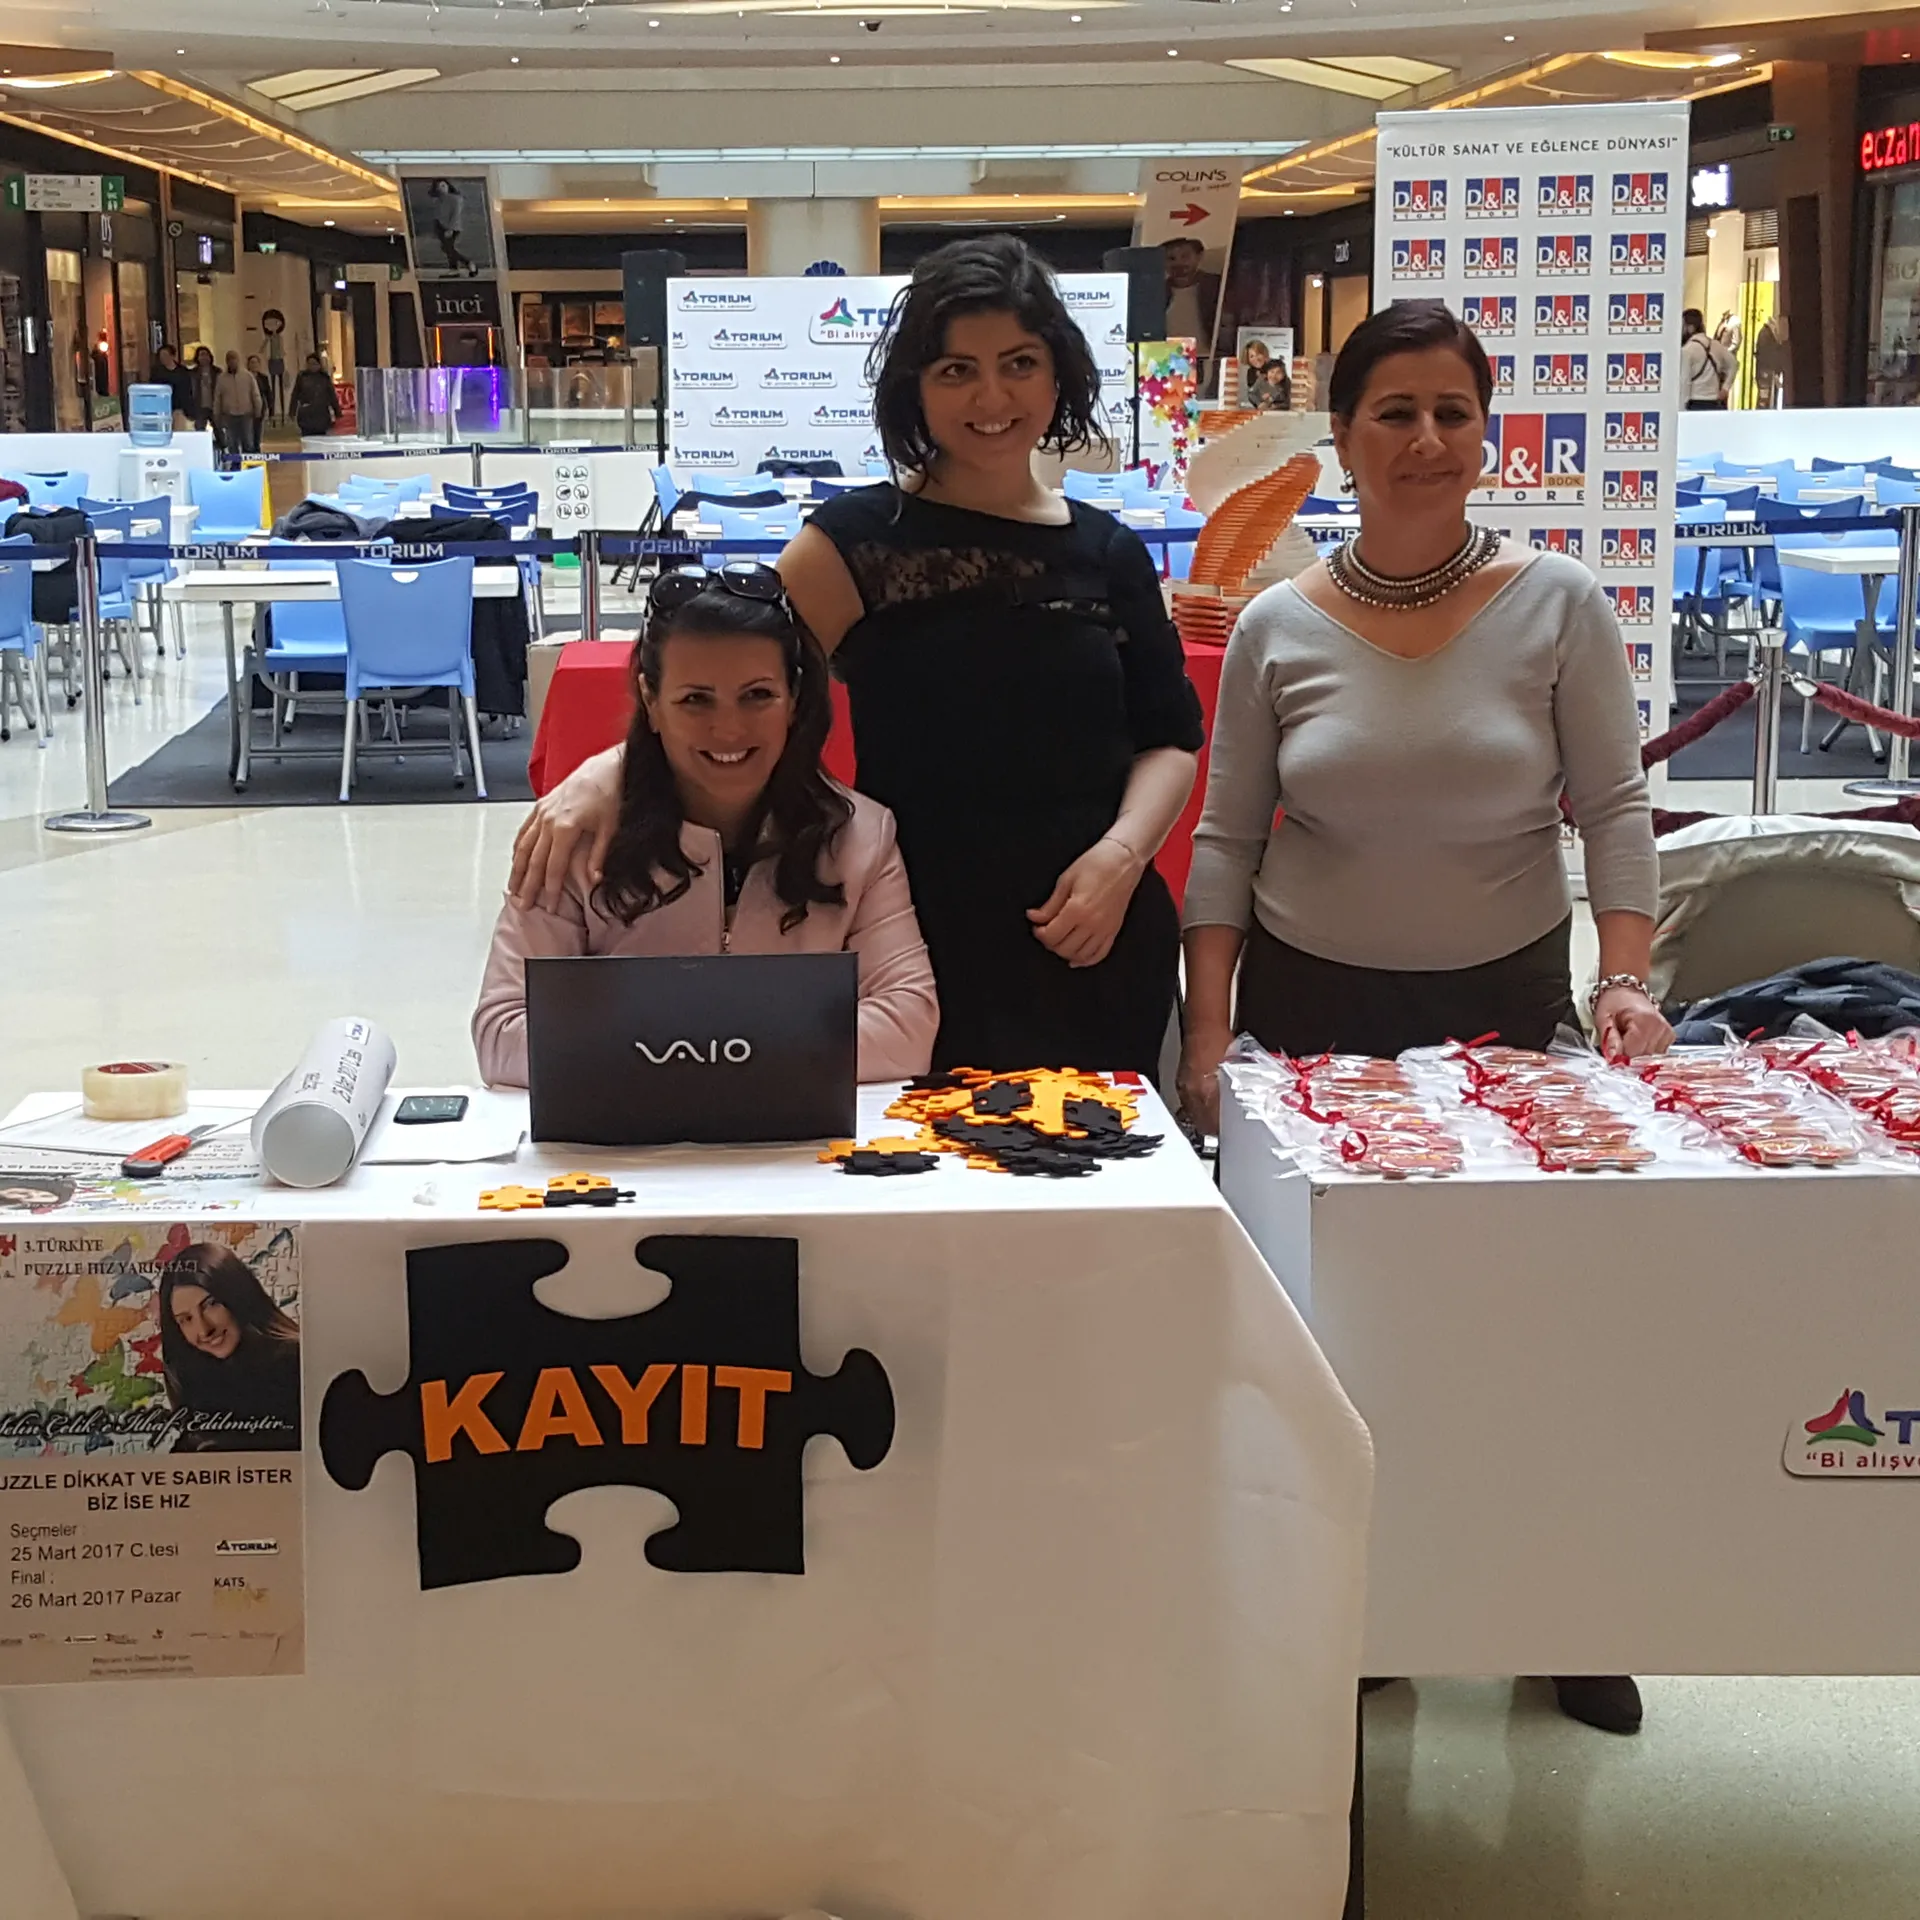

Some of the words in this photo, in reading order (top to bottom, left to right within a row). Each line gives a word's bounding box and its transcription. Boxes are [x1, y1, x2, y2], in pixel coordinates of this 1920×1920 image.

[1453, 144, 1499, 156] SANAT
[1507, 142, 1524, 154] VE
[1531, 138, 1599, 153] EĞLENCE
[1156, 168, 1227, 181] COLIN'S
[9, 181, 18, 204] 1
[1394, 191, 1445, 211] D&R
[1467, 188, 1517, 210] D&R
[1539, 186, 1591, 208] D&R
[1613, 184, 1667, 206] D&R
[1393, 249, 1445, 271] D&R
[1465, 247, 1516, 269] D&R
[1538, 245, 1590, 268] D&R
[1611, 243, 1666, 266] D&R
[436, 293, 483, 314] inci
[1609, 303, 1664, 325] D&R
[1463, 307, 1516, 328] D&R
[1535, 305, 1589, 327] D&R
[1535, 364, 1587, 386] D&R
[1607, 363, 1661, 385] D&R
[1606, 422, 1658, 443] D&R
[1548, 477, 1581, 486] BOOK
[1604, 480, 1657, 502] D&R
[1487, 490, 1585, 501] TORE
[1679, 522, 1767, 537] TORIUM
[168, 545, 258, 560] TORIUM
[354, 542, 444, 558] TORIUM
[1602, 537, 1655, 560] D&R
[635, 1038, 752, 1064] VAIO
[24, 1263, 83, 1276] PUZZLE
[88, 1263, 115, 1275] HIZ
[420, 1363, 792, 1464] KAYIT
[1856, 1451, 1920, 1471] alışv
[64, 1470, 136, 1489] DİKKAT
[141, 1471, 166, 1486] VE
[172, 1469, 231, 1486] SABIR
[237, 1466, 292, 1485] İSTER
[88, 1492, 118, 1511] BİZ
[124, 1492, 154, 1509] İSE
[160, 1494, 191, 1508] HIZ
[10, 1524, 77, 1541] Seçmeler
[11, 1547, 32, 1562] 25
[38, 1545, 76, 1560] Mart
[82, 1543, 124, 1559] 2017
[12, 1570, 46, 1585] Final
[12, 1593, 33, 1608] 26
[39, 1591, 77, 1607] Mart
[83, 1590, 125, 1605] 2017
[131, 1589, 182, 1604] Pazar
